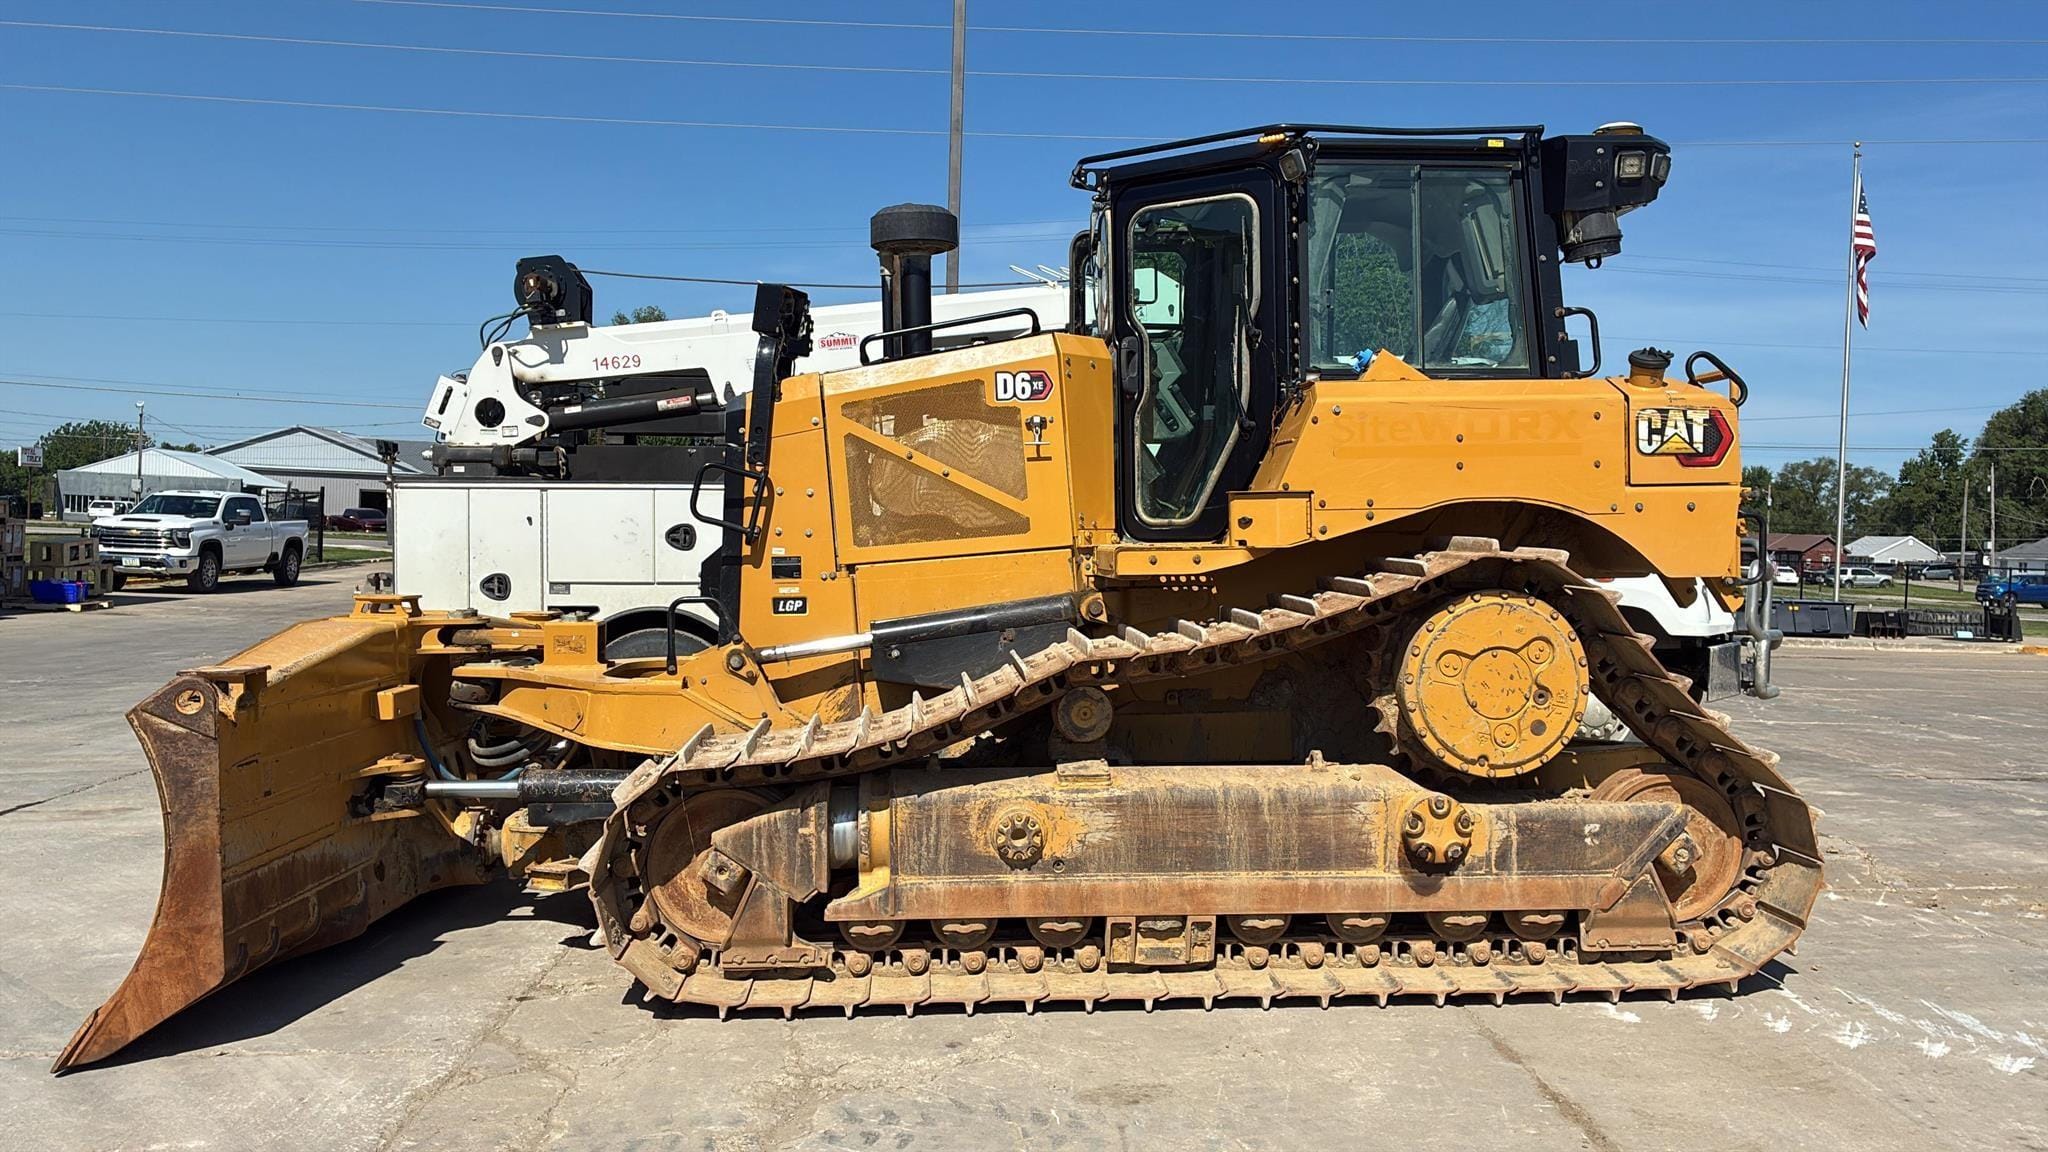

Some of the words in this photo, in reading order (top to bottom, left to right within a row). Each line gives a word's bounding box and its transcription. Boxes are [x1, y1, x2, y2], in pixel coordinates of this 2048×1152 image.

[820, 337, 857, 348] SUMMIT
[592, 354, 641, 371] 14629
[995, 370, 1032, 401] D6
[1032, 380, 1044, 391] XE
[1637, 408, 1710, 454] CAT
[778, 600, 803, 612] LGP
